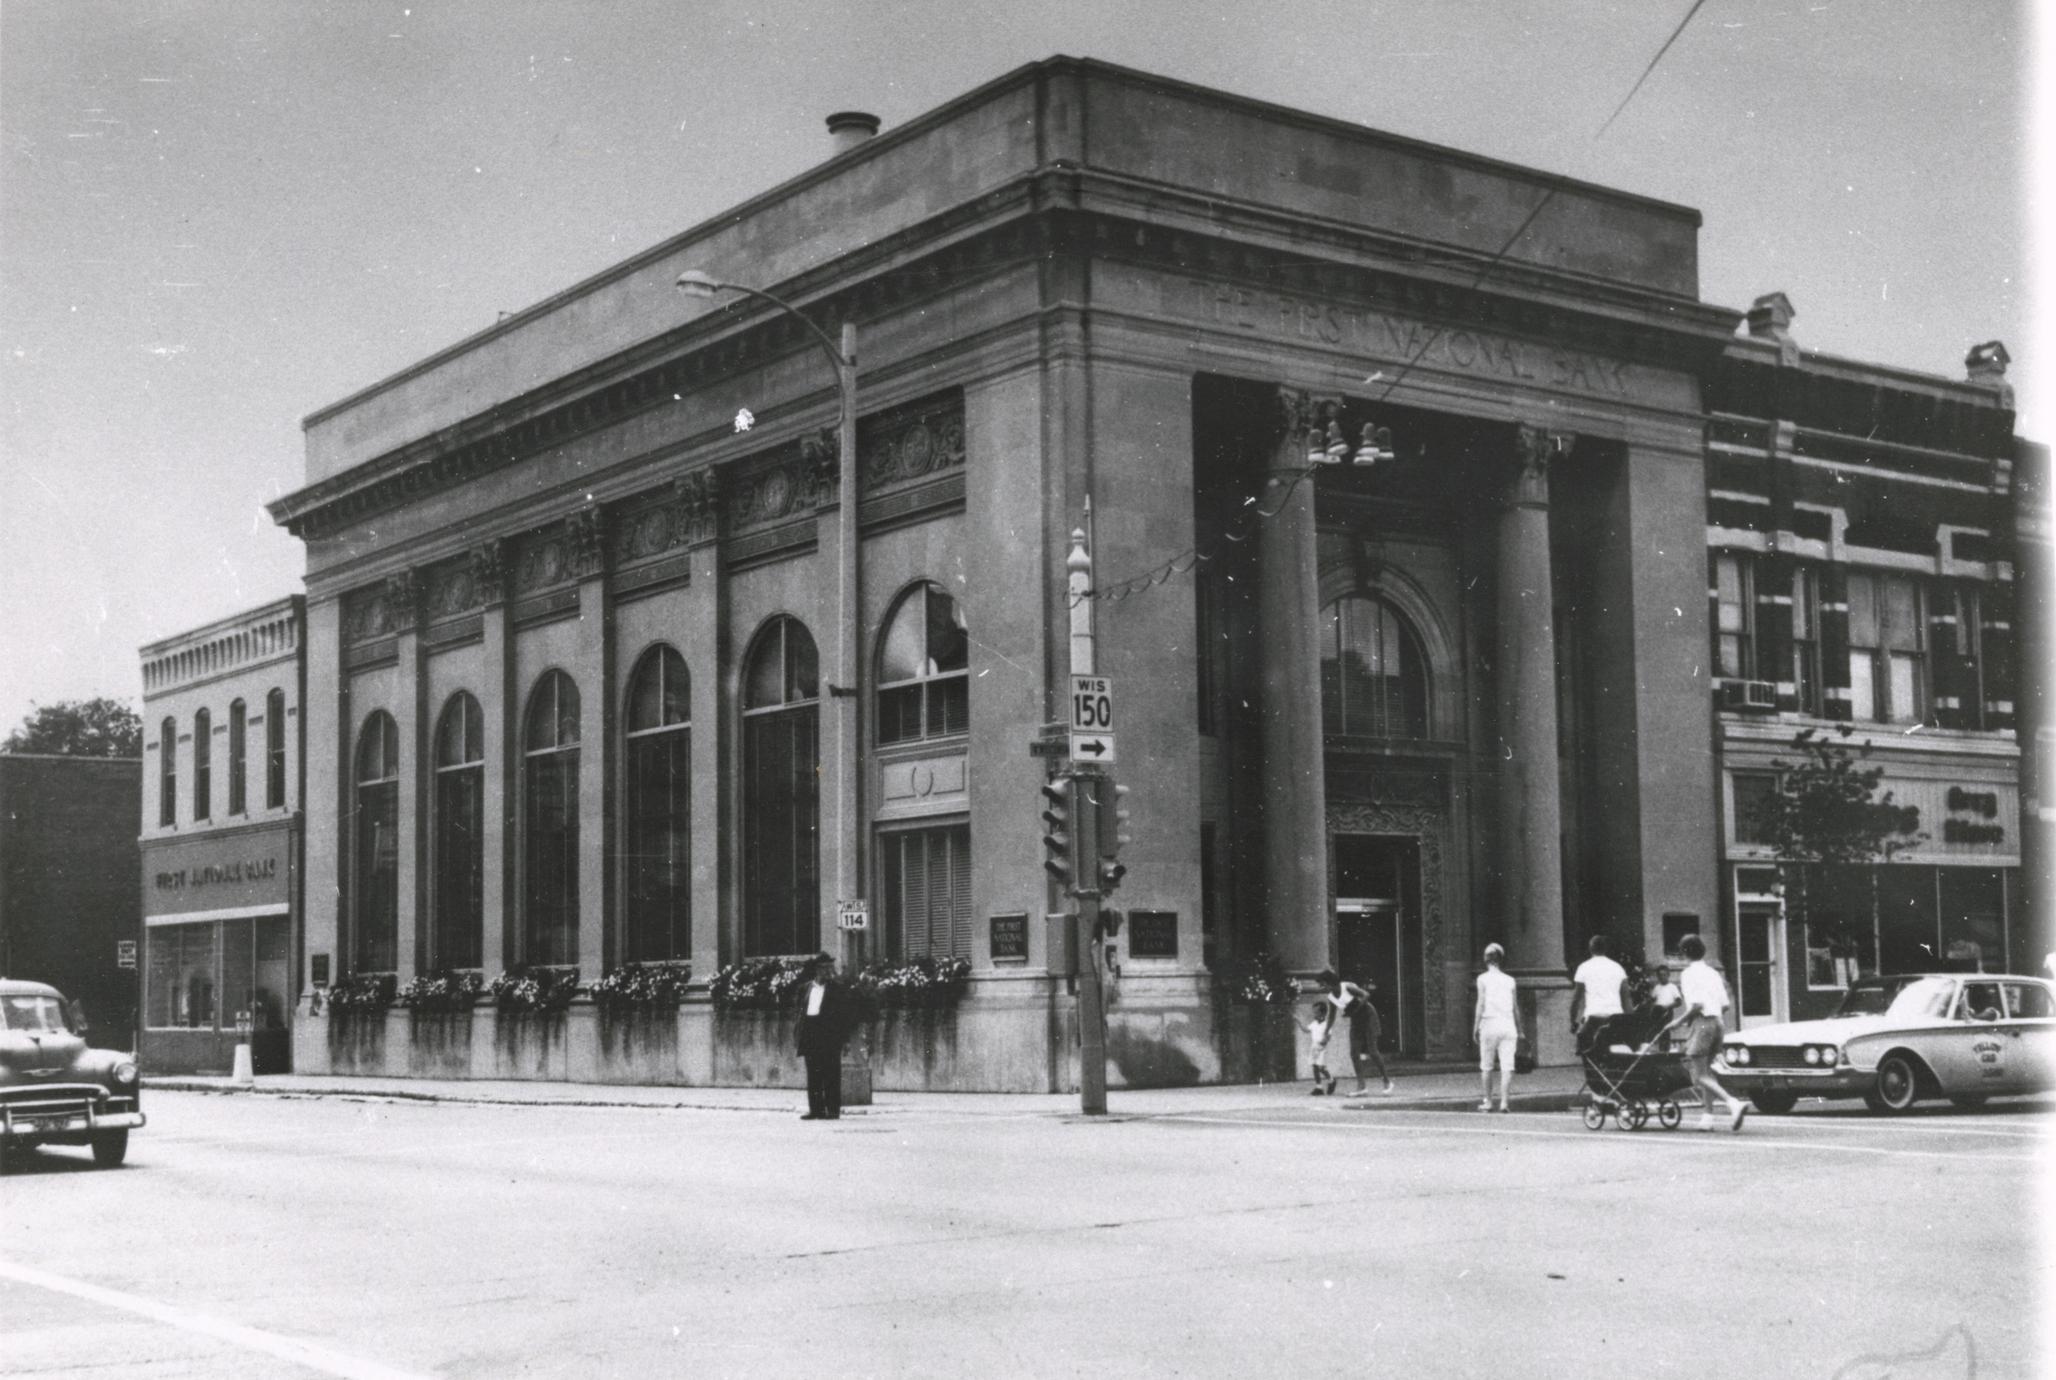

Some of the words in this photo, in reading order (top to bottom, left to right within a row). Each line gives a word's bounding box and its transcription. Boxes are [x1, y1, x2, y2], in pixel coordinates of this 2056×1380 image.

[1277, 296, 1367, 349] FRST
[1377, 312, 1536, 380] NATIONAL
[1078, 680, 1105, 692] WIS
[1074, 694, 1111, 728] 150
[845, 914, 864, 926] 114
[994, 932, 1023, 943] NATIONAL
